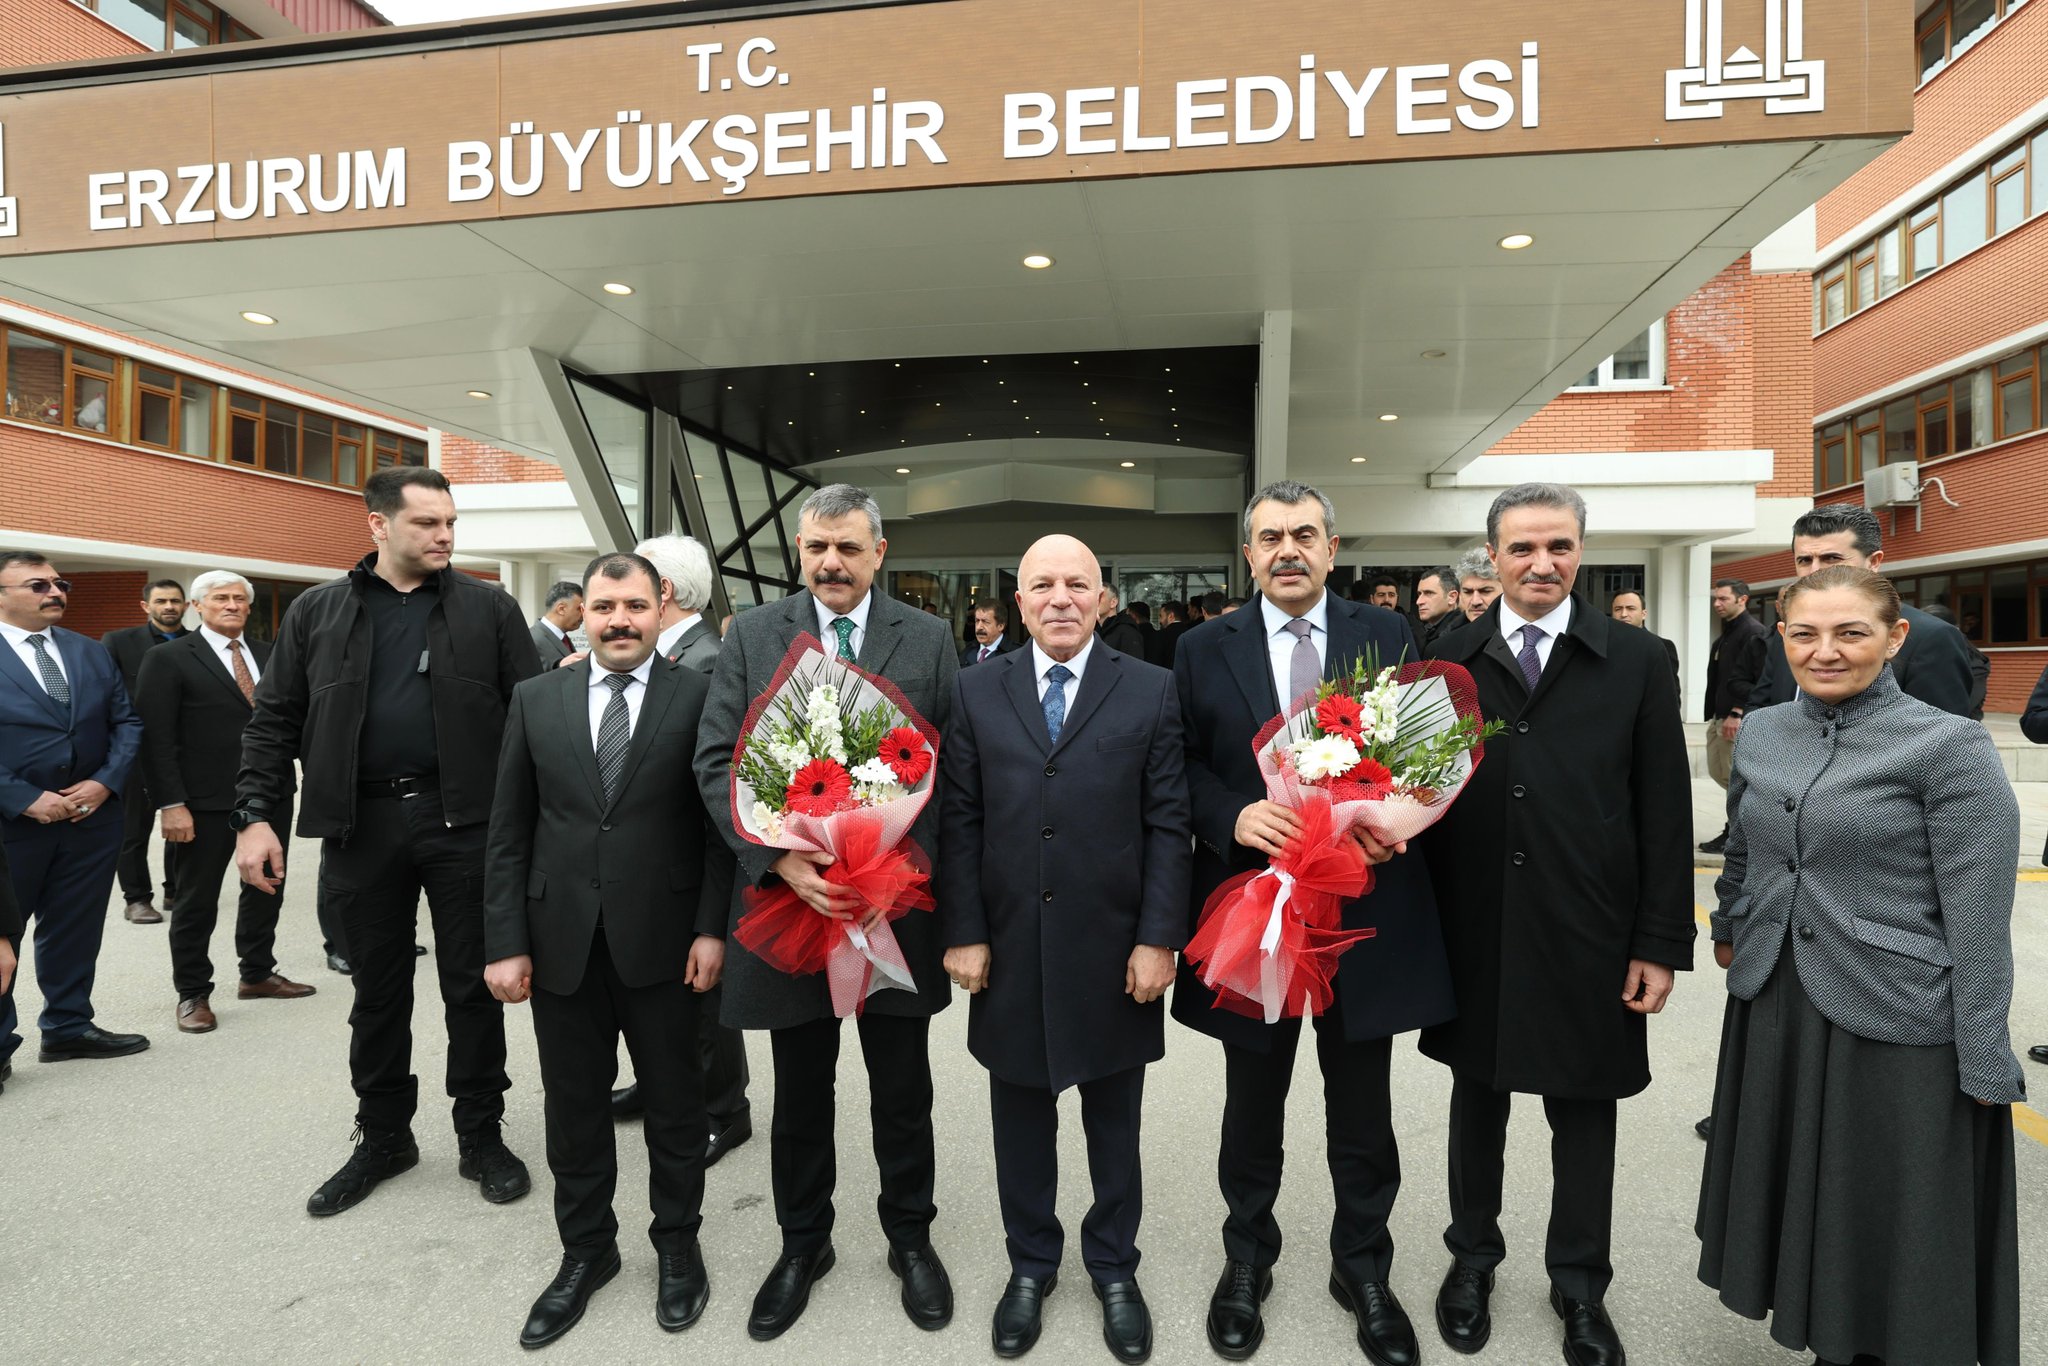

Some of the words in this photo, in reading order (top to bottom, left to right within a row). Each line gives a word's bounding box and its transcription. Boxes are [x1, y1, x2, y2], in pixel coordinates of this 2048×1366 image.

[686, 37, 789, 92] T.C.
[88, 147, 406, 231] ERZURUM
[447, 87, 949, 203] BÜYÜKŞEHİR
[1003, 41, 1539, 159] BELEDİYESİ
